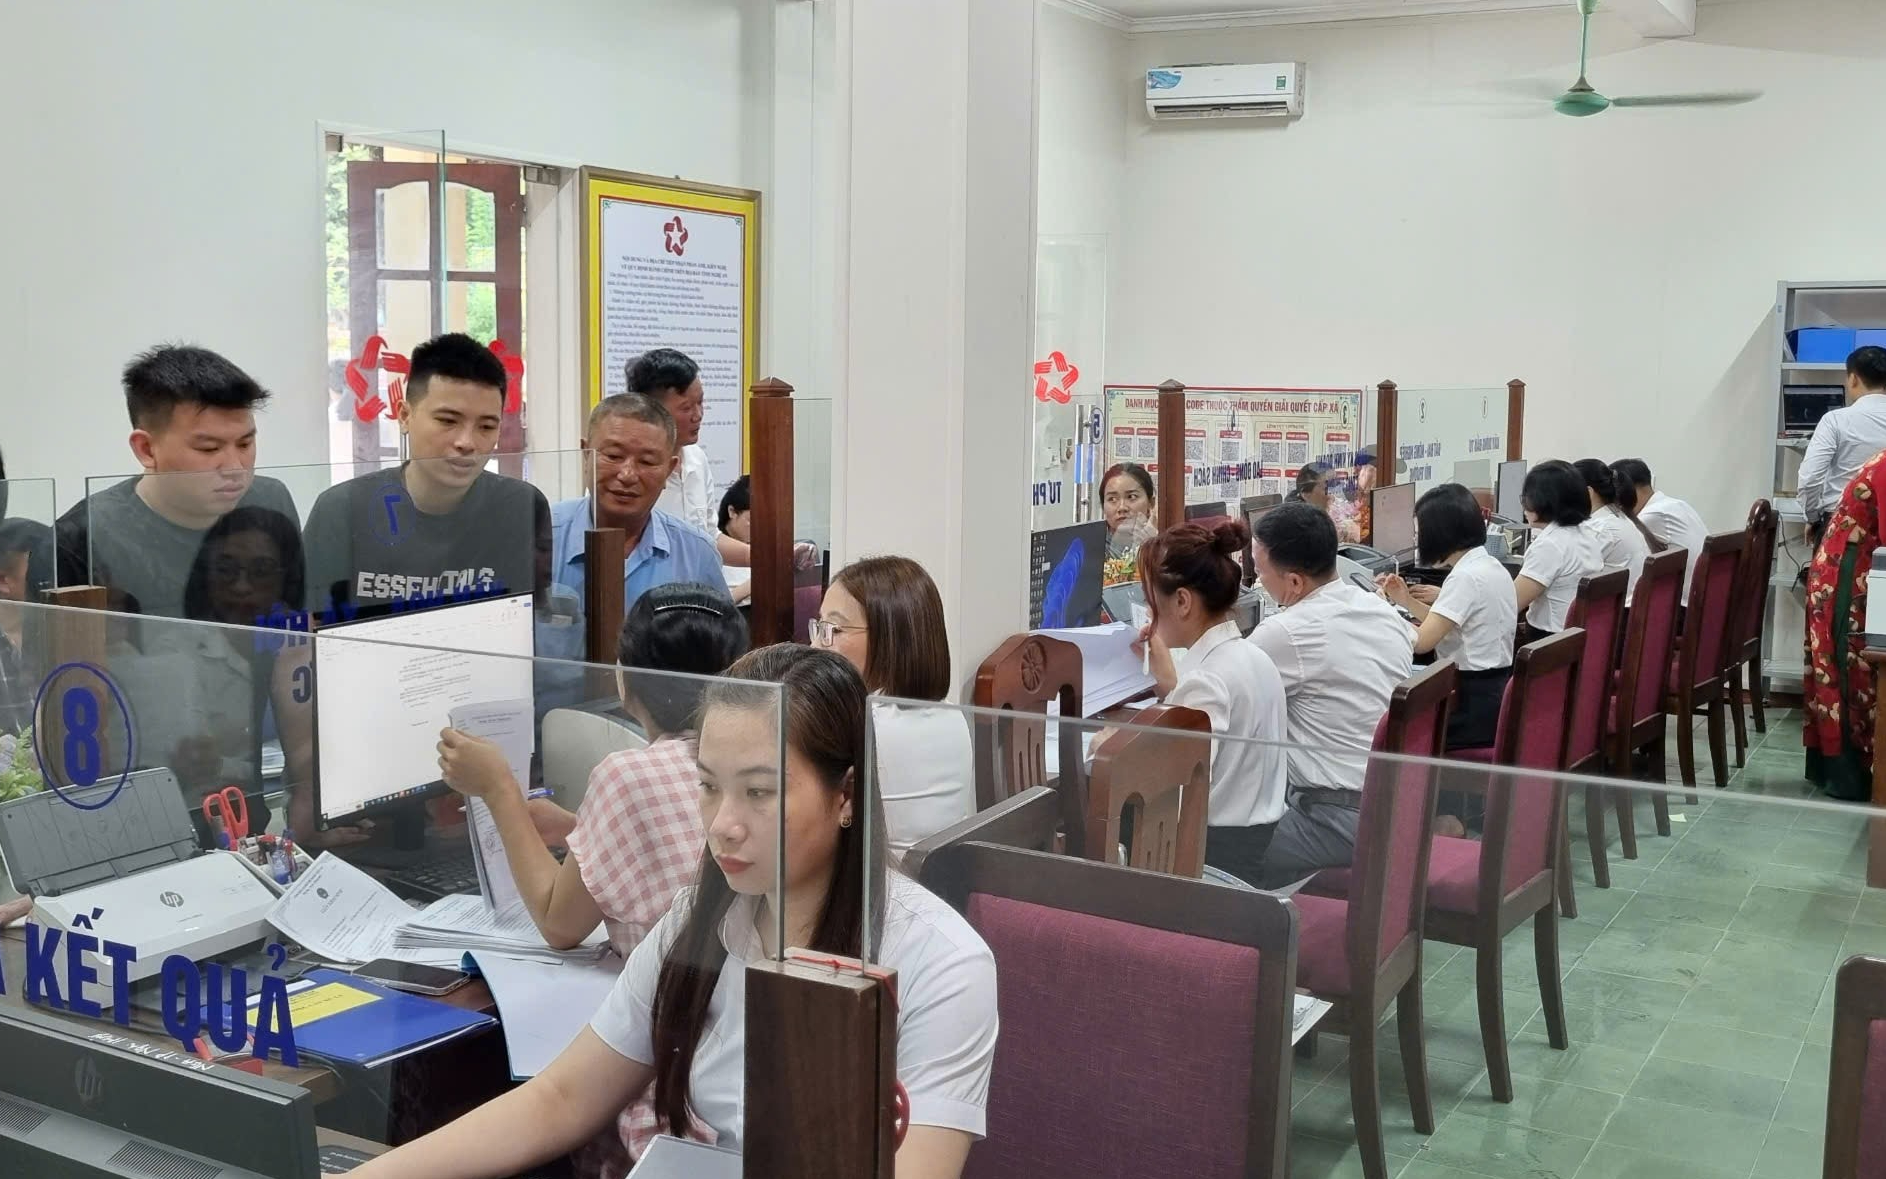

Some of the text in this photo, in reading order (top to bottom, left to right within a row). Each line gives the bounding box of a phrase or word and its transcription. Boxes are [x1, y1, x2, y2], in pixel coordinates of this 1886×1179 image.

[1125, 398, 1143, 409] DANH
[1186, 399, 1204, 410] CODE
[1274, 398, 1289, 412] GIẢI
[1290, 398, 1312, 414] QUYẾT
[62, 686, 99, 787] 8
[24, 907, 299, 1069] KẾT QUẢ
